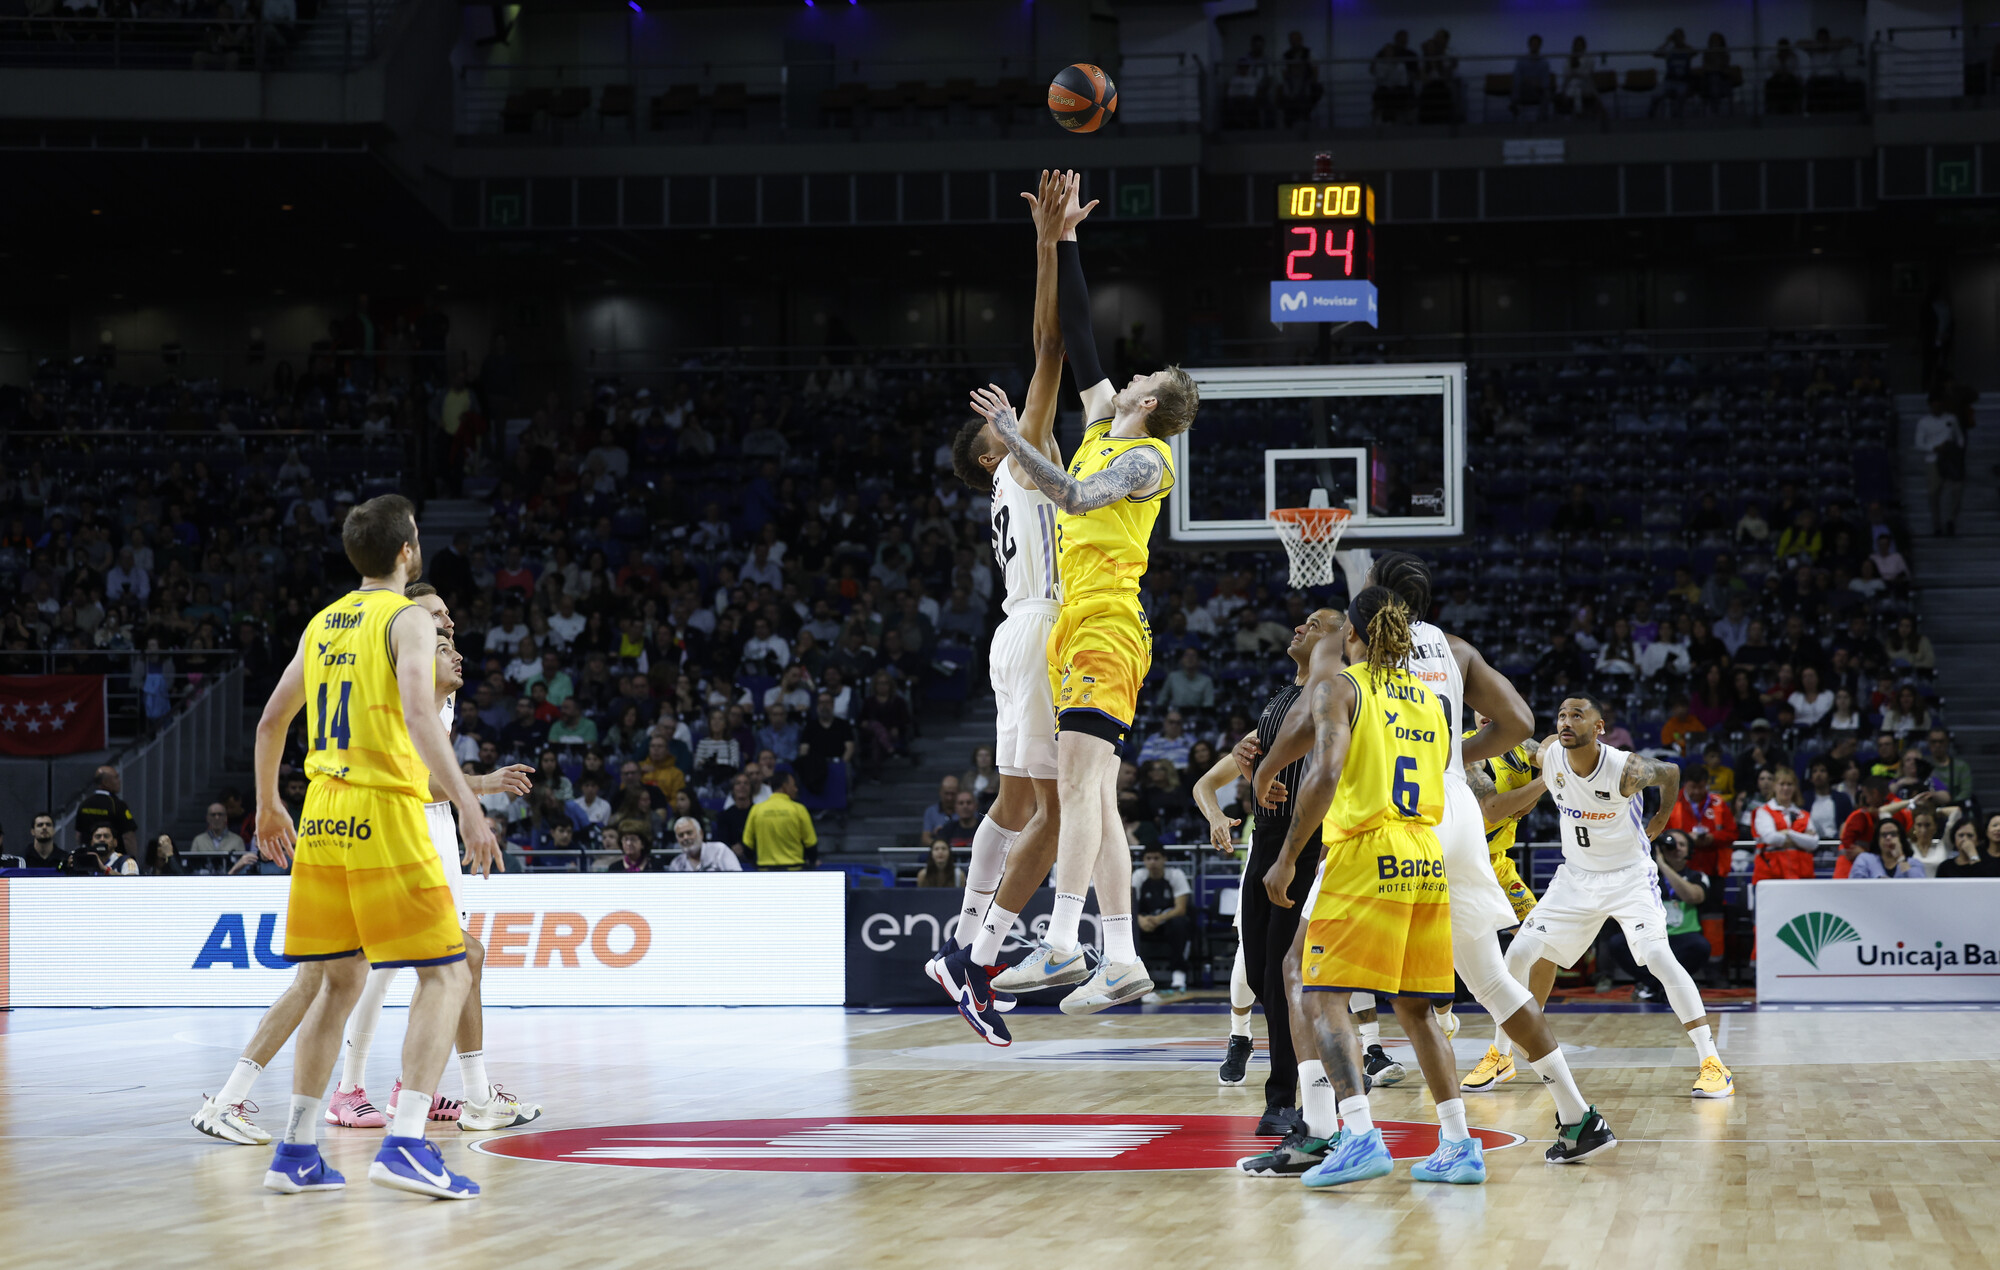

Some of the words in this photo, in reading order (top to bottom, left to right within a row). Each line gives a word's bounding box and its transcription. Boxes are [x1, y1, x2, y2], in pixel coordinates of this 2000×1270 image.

[1290, 186, 1361, 216] 10:00
[1286, 226, 1354, 280] 24
[1313, 296, 1358, 306] Movistar
[314, 681, 352, 751] 14
[1392, 755, 1422, 817] 6
[1575, 826, 1591, 848] 8
[1377, 855, 1447, 880] Barcel
[191, 911, 652, 970] AUERO
[1857, 941, 1958, 971] Unicaja
